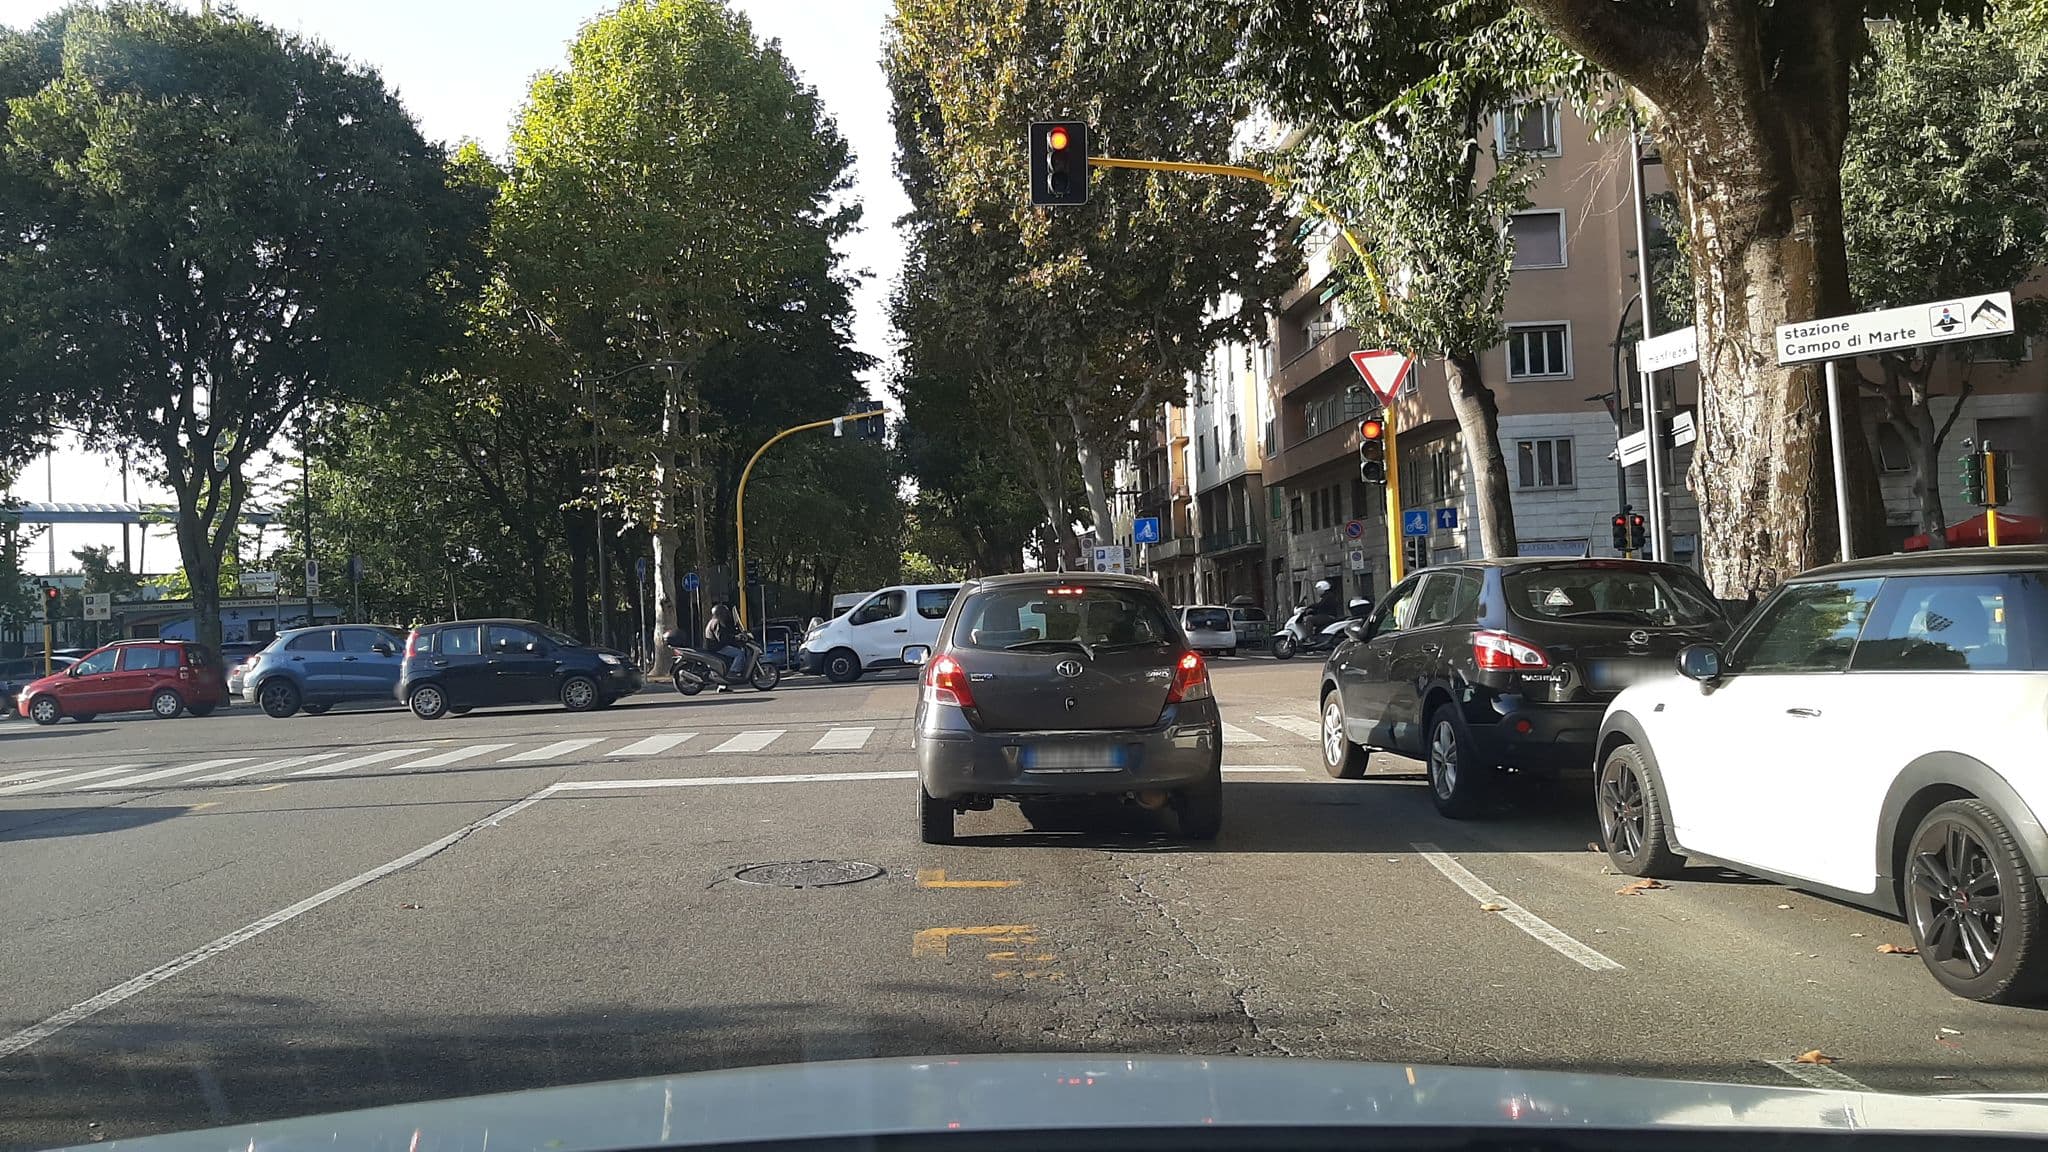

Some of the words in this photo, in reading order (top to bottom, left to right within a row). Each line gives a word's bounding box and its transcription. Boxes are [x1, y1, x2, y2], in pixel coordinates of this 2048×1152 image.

[1785, 322, 1850, 339] stazione
[1786, 340, 1841, 355] Campo
[1847, 334, 1862, 348] di
[1869, 328, 1916, 344] Marte
